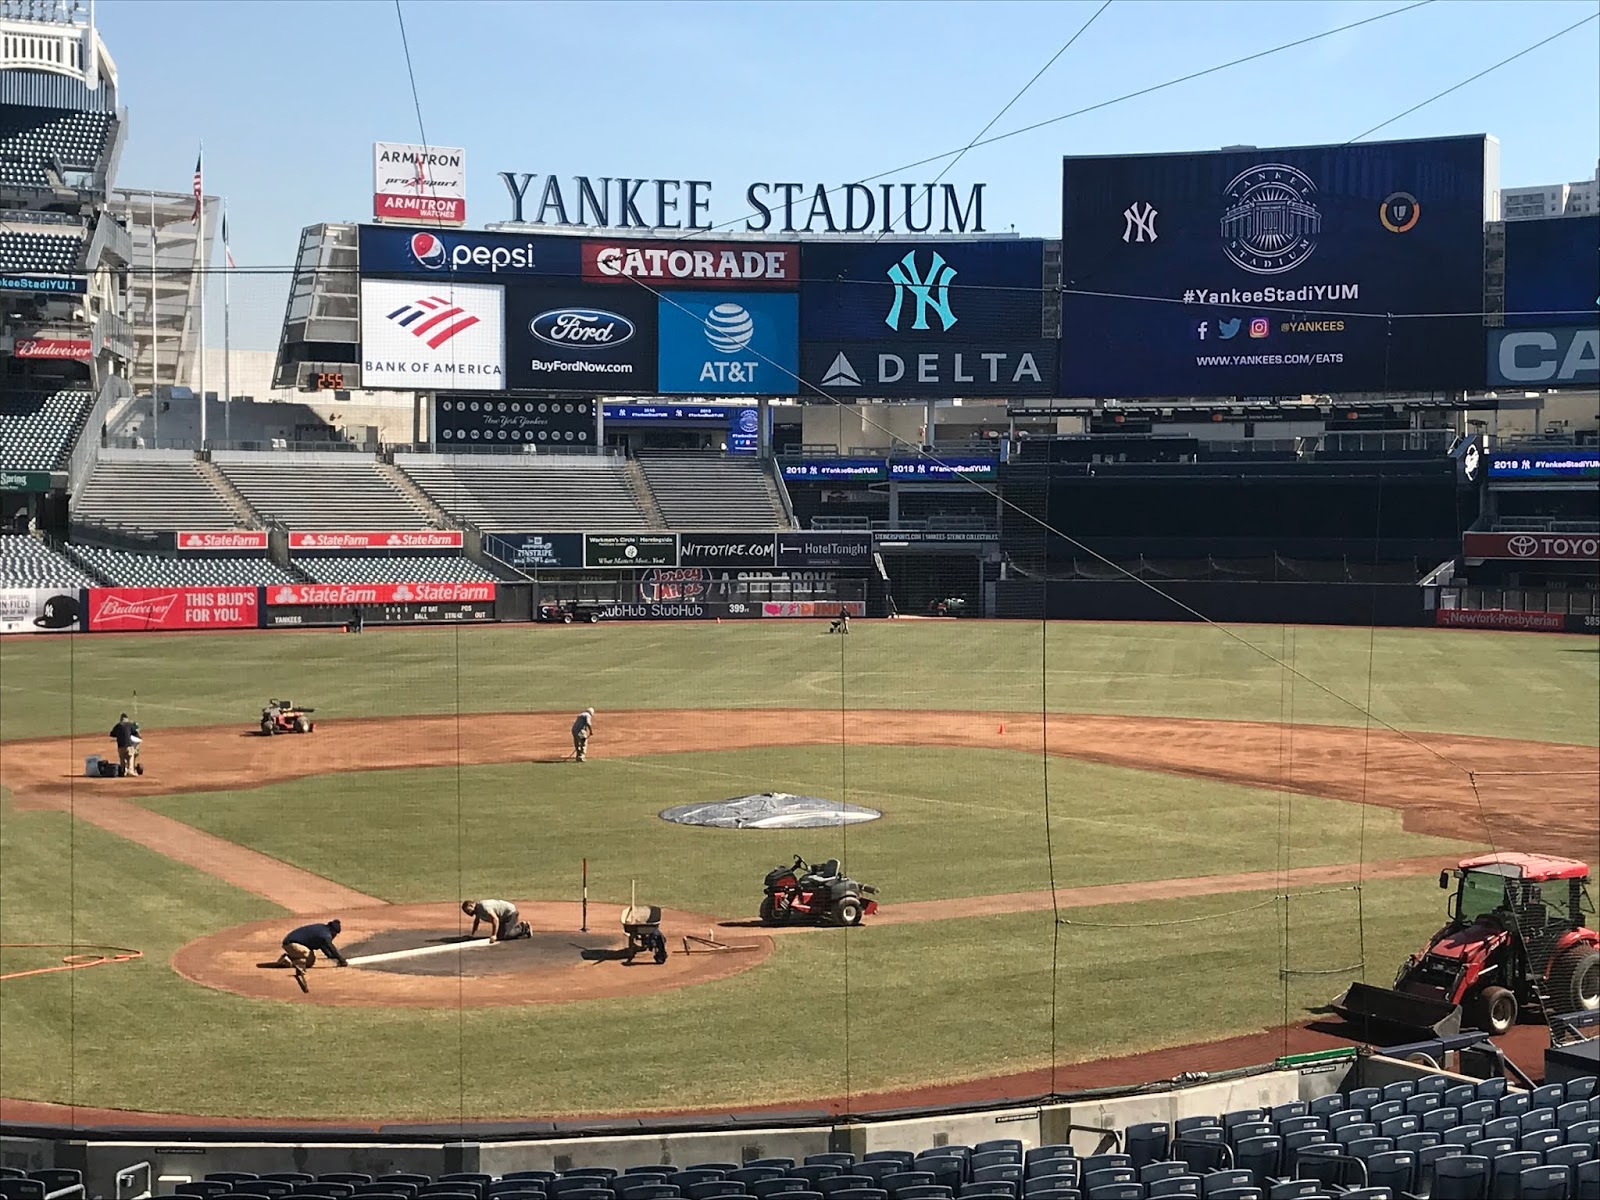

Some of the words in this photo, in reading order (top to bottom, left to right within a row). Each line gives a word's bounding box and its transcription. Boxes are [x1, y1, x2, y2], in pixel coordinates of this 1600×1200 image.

[380, 151, 460, 167] ARMITRON
[1231, 172, 1309, 198] YANKEE
[384, 197, 457, 212] ARMITRON
[497, 171, 713, 231] YANKEE
[746, 181, 987, 233] STADIUM
[420, 209, 455, 218] WATCHES
[452, 243, 534, 273] pepsi
[1230, 239, 1309, 267] STADIUM
[597, 247, 786, 280] GATORADE
[1183, 284, 1359, 305] #YankeeStadiYUM
[550, 313, 614, 343] Ford
[1281, 321, 1345, 333] @YANKEES
[17, 341, 91, 357] Budweiser
[1196, 353, 1344, 366] WWW.YANKEES.COM/EATS
[365, 361, 407, 373] BANK
[411, 362, 430, 373] OF
[434, 363, 502, 376] AMERICA
[532, 360, 633, 374] BuyFordNow.com
[700, 361, 758, 382] AT&T
[878, 352, 1042, 383] DELTA
[786, 466, 807, 474] 2019
[892, 465, 914, 473] 2019
[1494, 461, 1518, 470] 2019
[0, 472, 27, 487] Spring
[681, 543, 774, 557] NITTOTIRE.COM
[1541, 539, 1600, 555] TOYO
[185, 593, 218, 606] THIS
[219, 592, 254, 606] BUD'S
[103, 601, 169, 615] Budweiser
[185, 609, 214, 622] FOR
[218, 608, 242, 622] YOU.
[651, 604, 703, 617] StubHub
[728, 604, 744, 614] 399
[274, 616, 302, 624] YANKEES
[1584, 616, 1600, 626] 385
